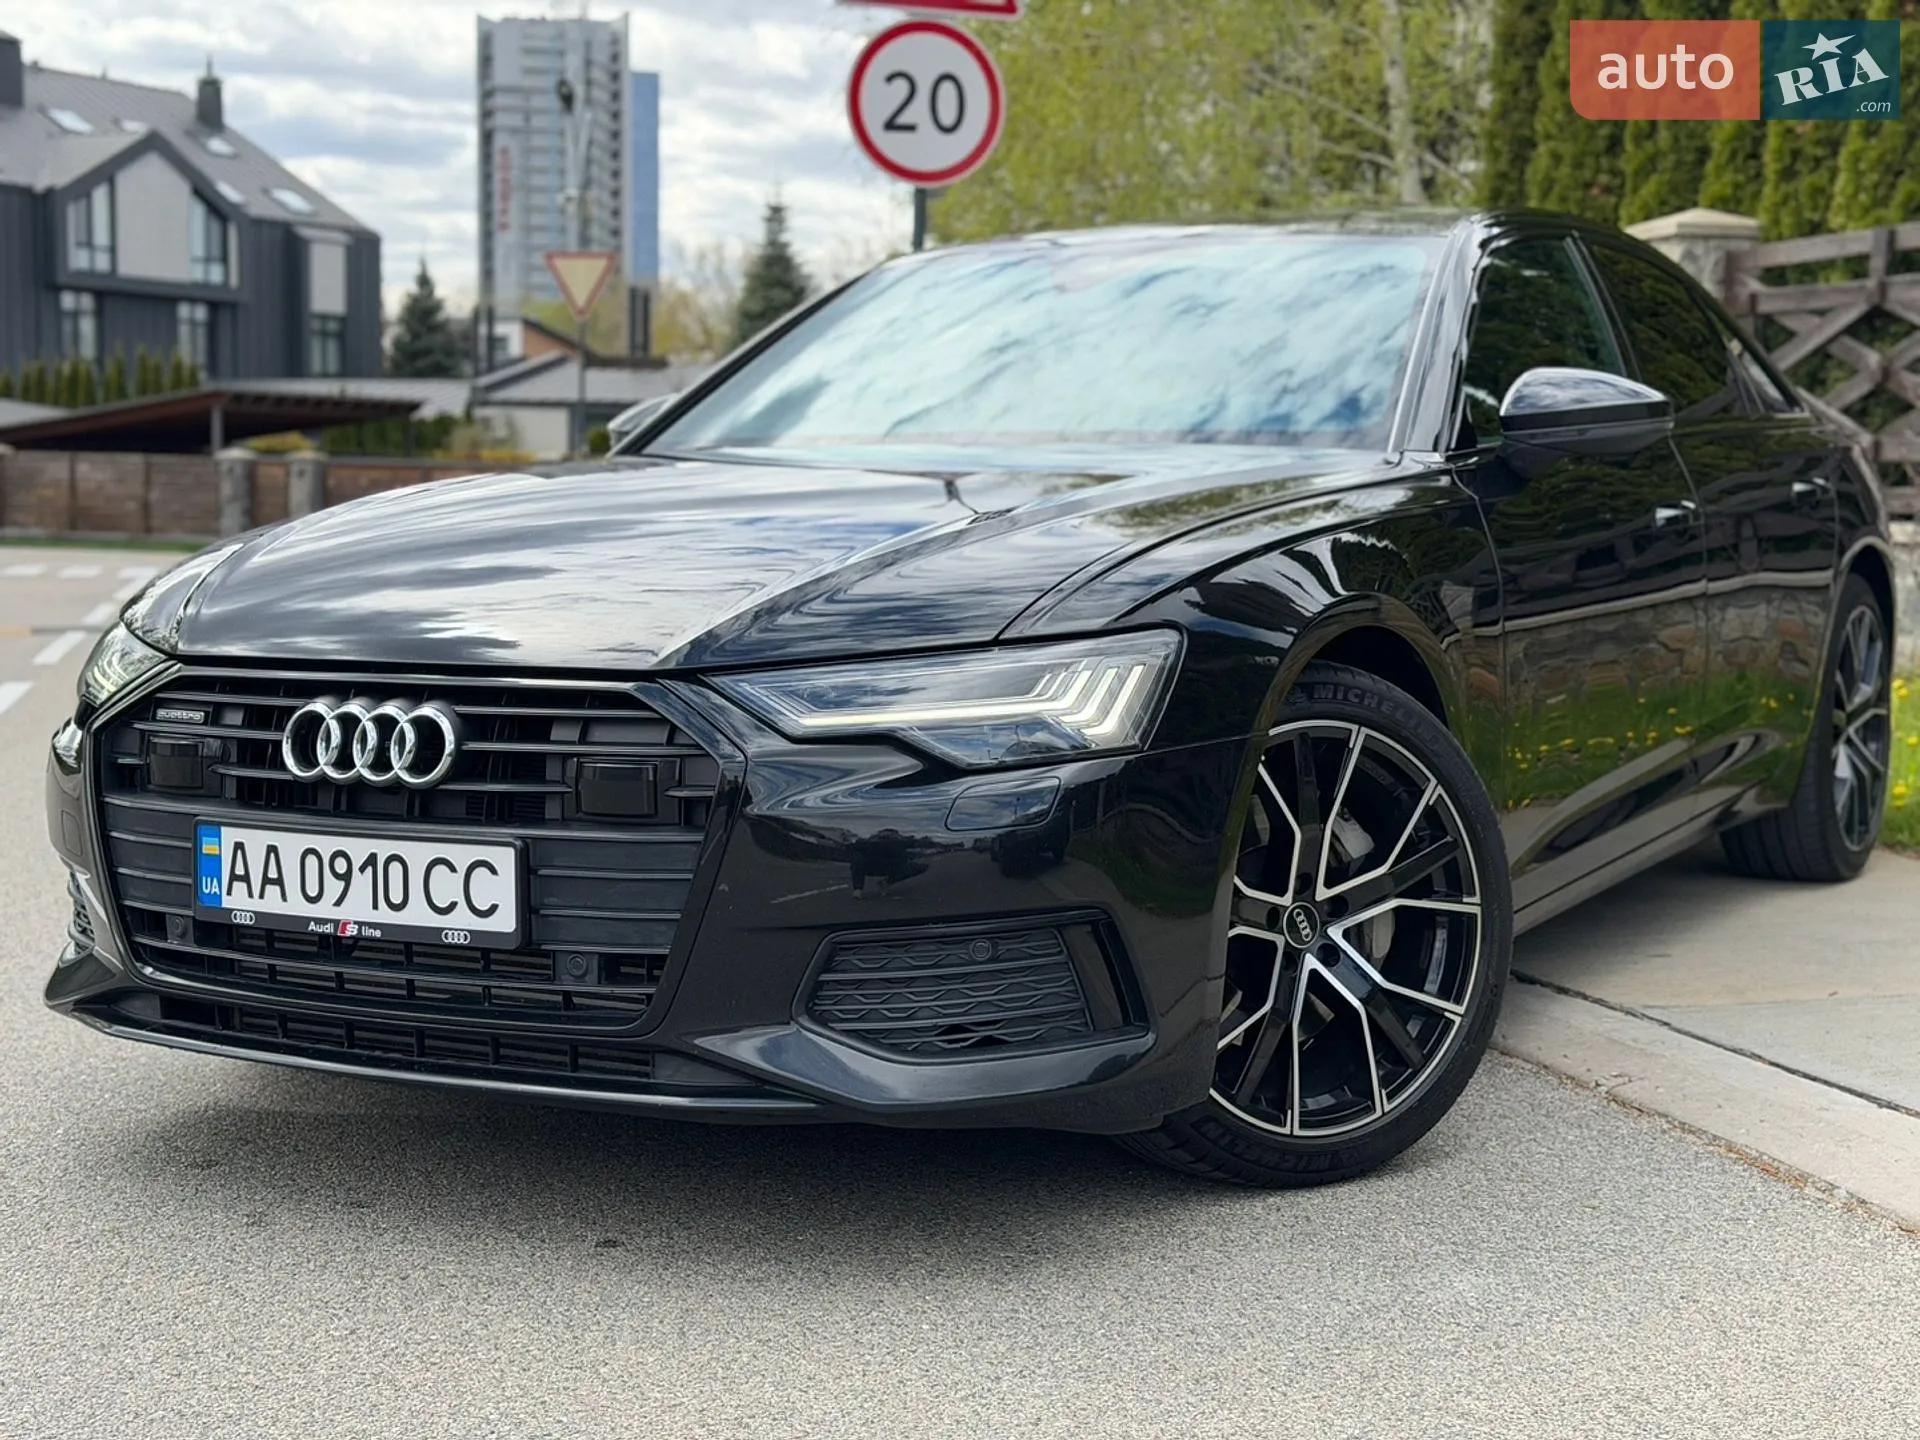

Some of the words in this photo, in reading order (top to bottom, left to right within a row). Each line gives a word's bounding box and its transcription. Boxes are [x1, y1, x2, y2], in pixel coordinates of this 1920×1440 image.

[883, 70, 965, 134] 20
[156, 710, 202, 722] quattro
[202, 877, 220, 896] UA
[226, 841, 288, 903] AA
[299, 847, 409, 912] 0910
[423, 856, 500, 918] CC
[308, 920, 334, 933] Audi
[361, 925, 382, 938] line
